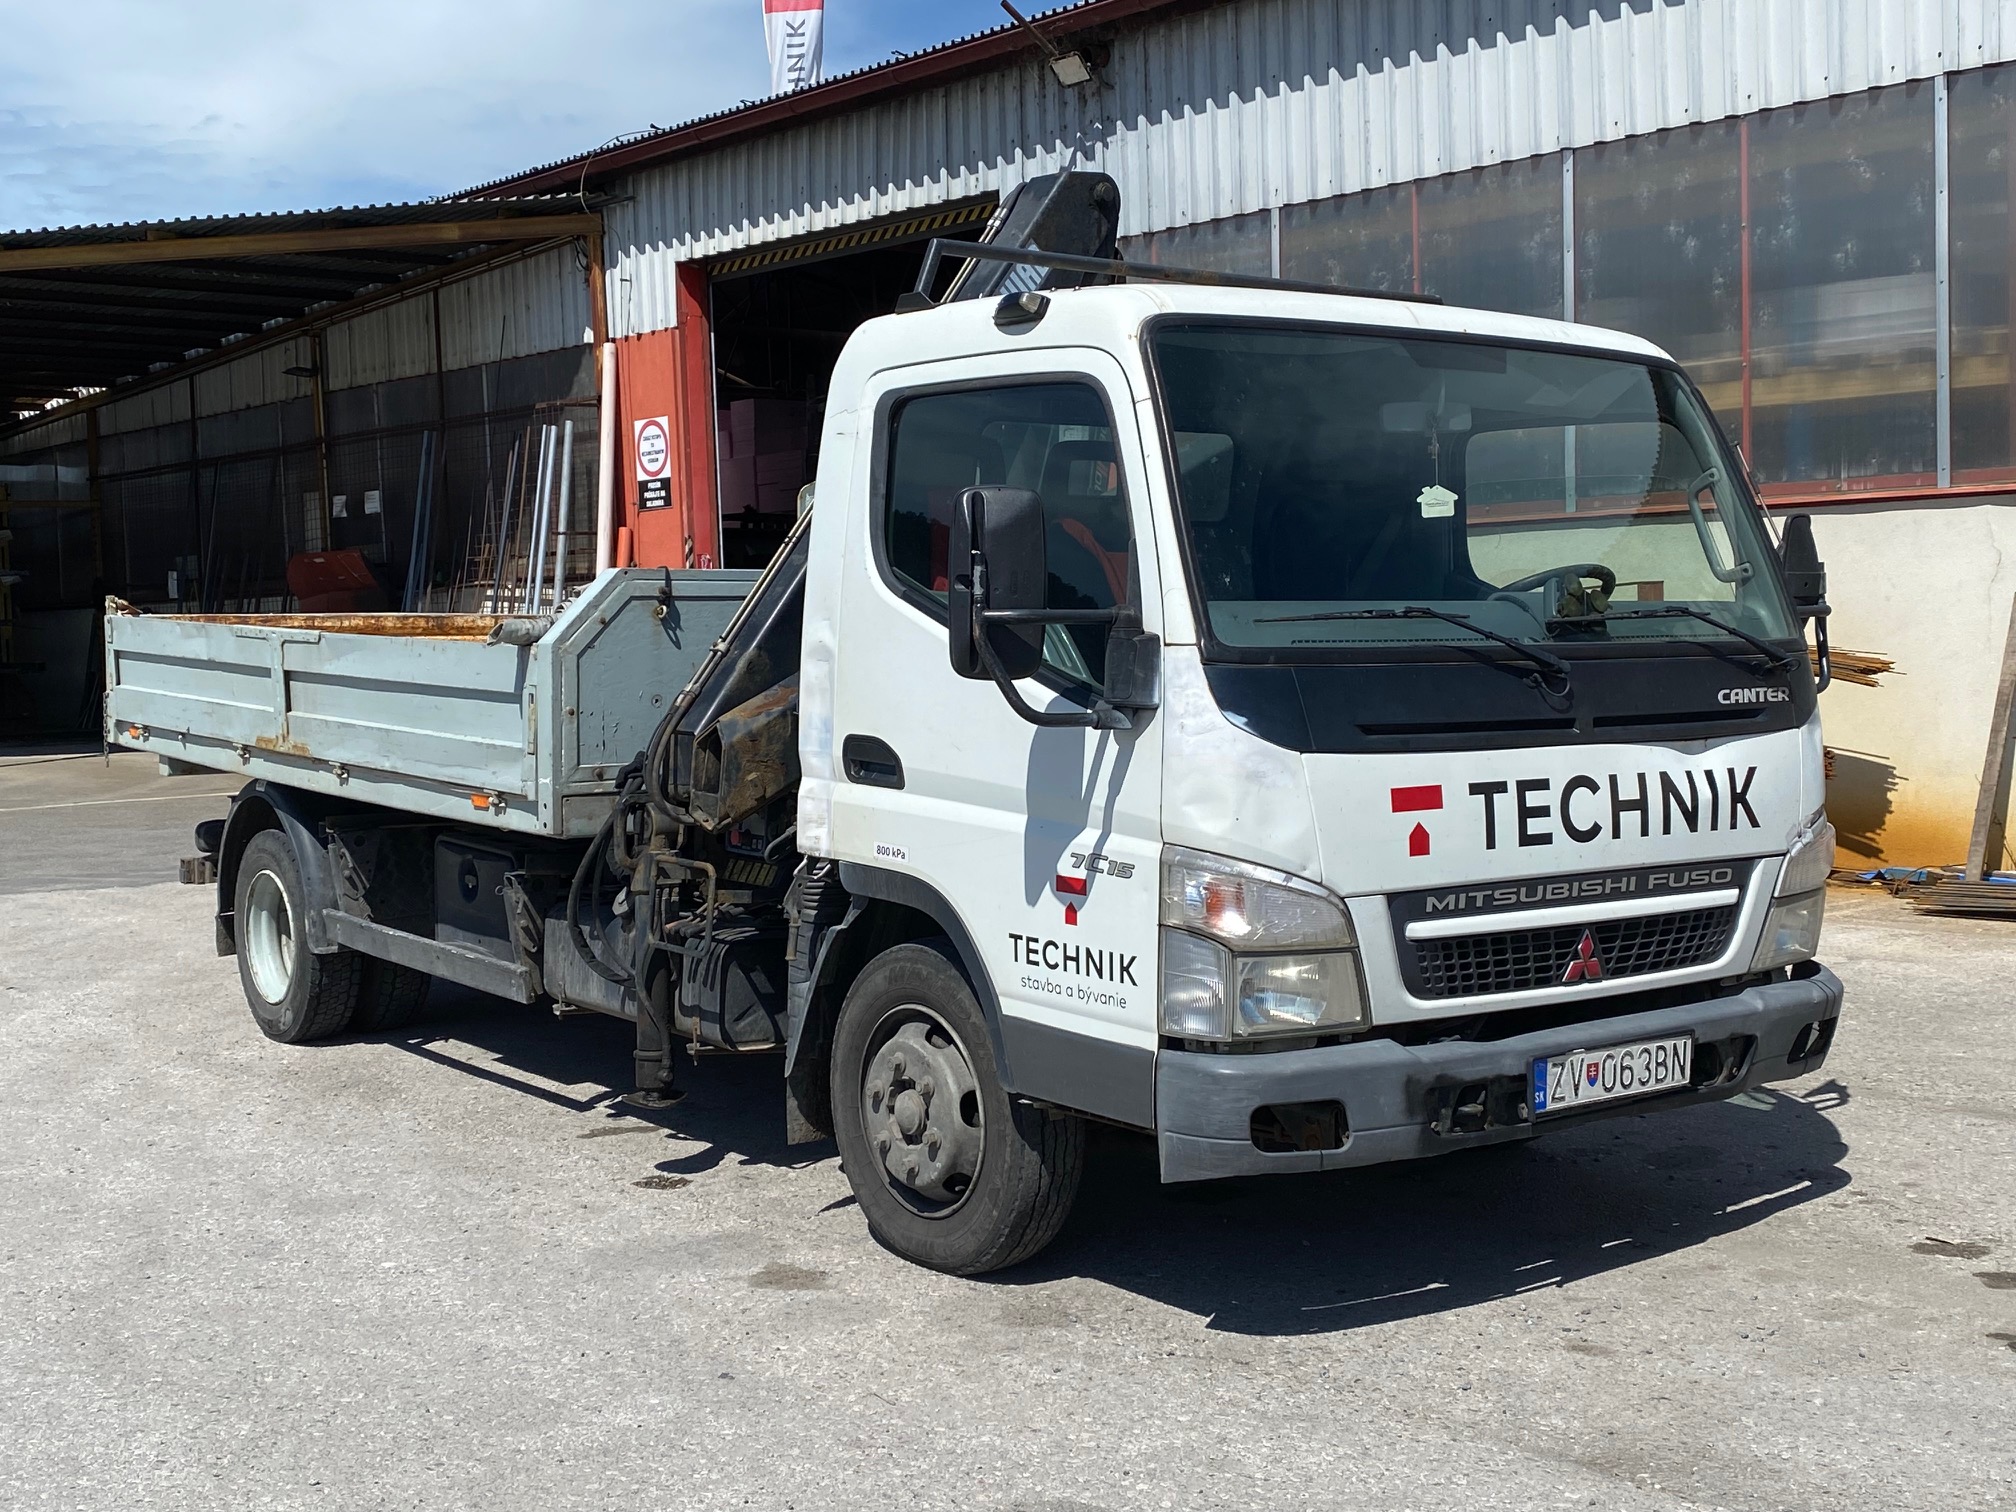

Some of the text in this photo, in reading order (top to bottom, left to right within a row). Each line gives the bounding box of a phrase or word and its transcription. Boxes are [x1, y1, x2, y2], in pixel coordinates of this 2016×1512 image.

[1717, 686, 1790, 704] CANTER
[1468, 765, 1762, 850] TECHNIK
[876, 844, 906, 860] 800 kPa
[1070, 852, 1136, 879] 7C15
[1425, 867, 1733, 913] MITSUBISHI FUSO
[1008, 932, 1139, 987] TECHNIK
[1021, 974, 1128, 1010] stavba a bývanie
[1550, 1040, 1688, 1103] ZV 063BN
[1534, 1090, 1545, 1103] SK
